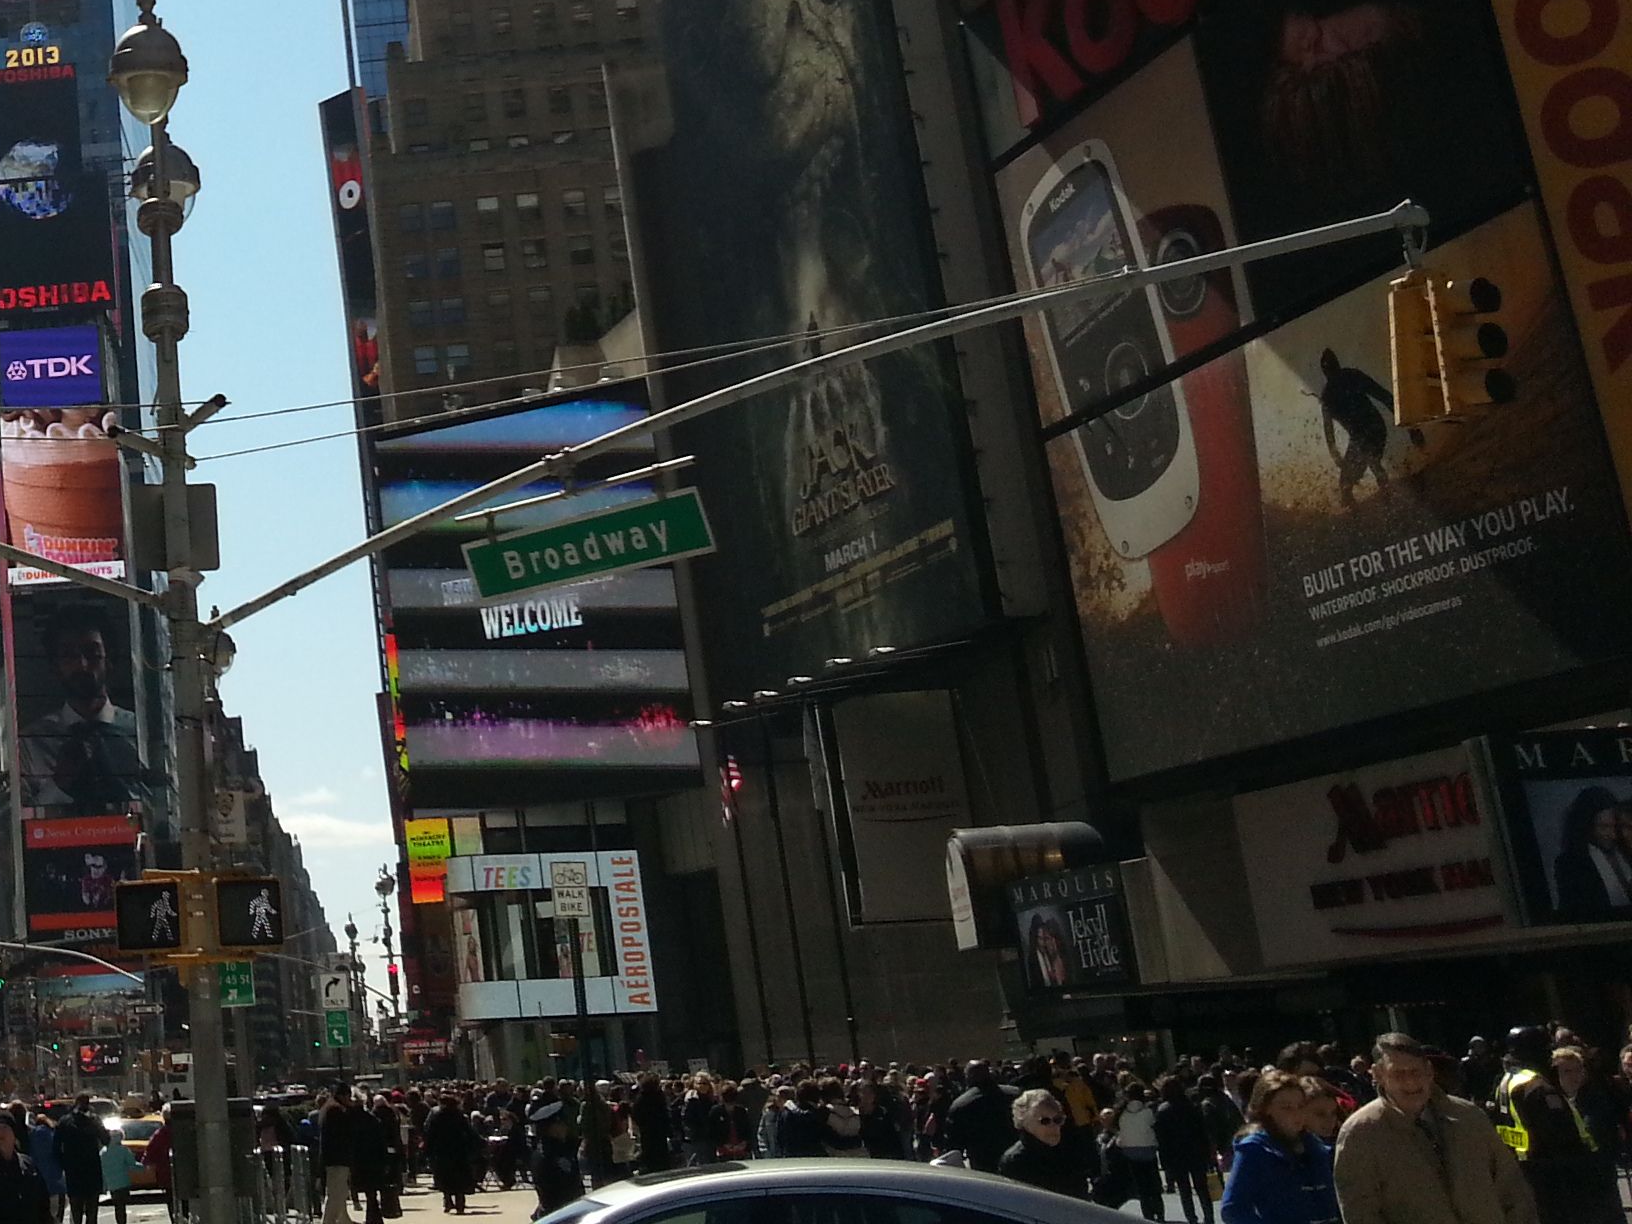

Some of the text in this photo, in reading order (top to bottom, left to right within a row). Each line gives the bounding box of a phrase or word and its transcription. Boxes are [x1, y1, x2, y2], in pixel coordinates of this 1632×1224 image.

[5, 45, 60, 68] 2013
[1048, 180, 1076, 216] Kodak
[26, 354, 94, 379] TDK
[838, 462, 896, 511] SLAYER
[501, 515, 671, 581] Broadway
[824, 531, 878, 573] MARCH 1
[1302, 486, 1576, 599] BUILT FOR THE WAY YOU PLAY.
[1308, 535, 1539, 622] WATERPROOF. SHOCKPROOF. DUSTPROOF.
[479, 593, 584, 640] WELCOME
[483, 866, 532, 889] TEES
[557, 888, 585, 899] WALK
[1011, 868, 1115, 905] MARQUIS
[560, 902, 584, 913] BIKE
[1067, 903, 1109, 947] Jekyll
[64, 927, 113, 941] SONY
[1077, 934, 1121, 969] Hyde
